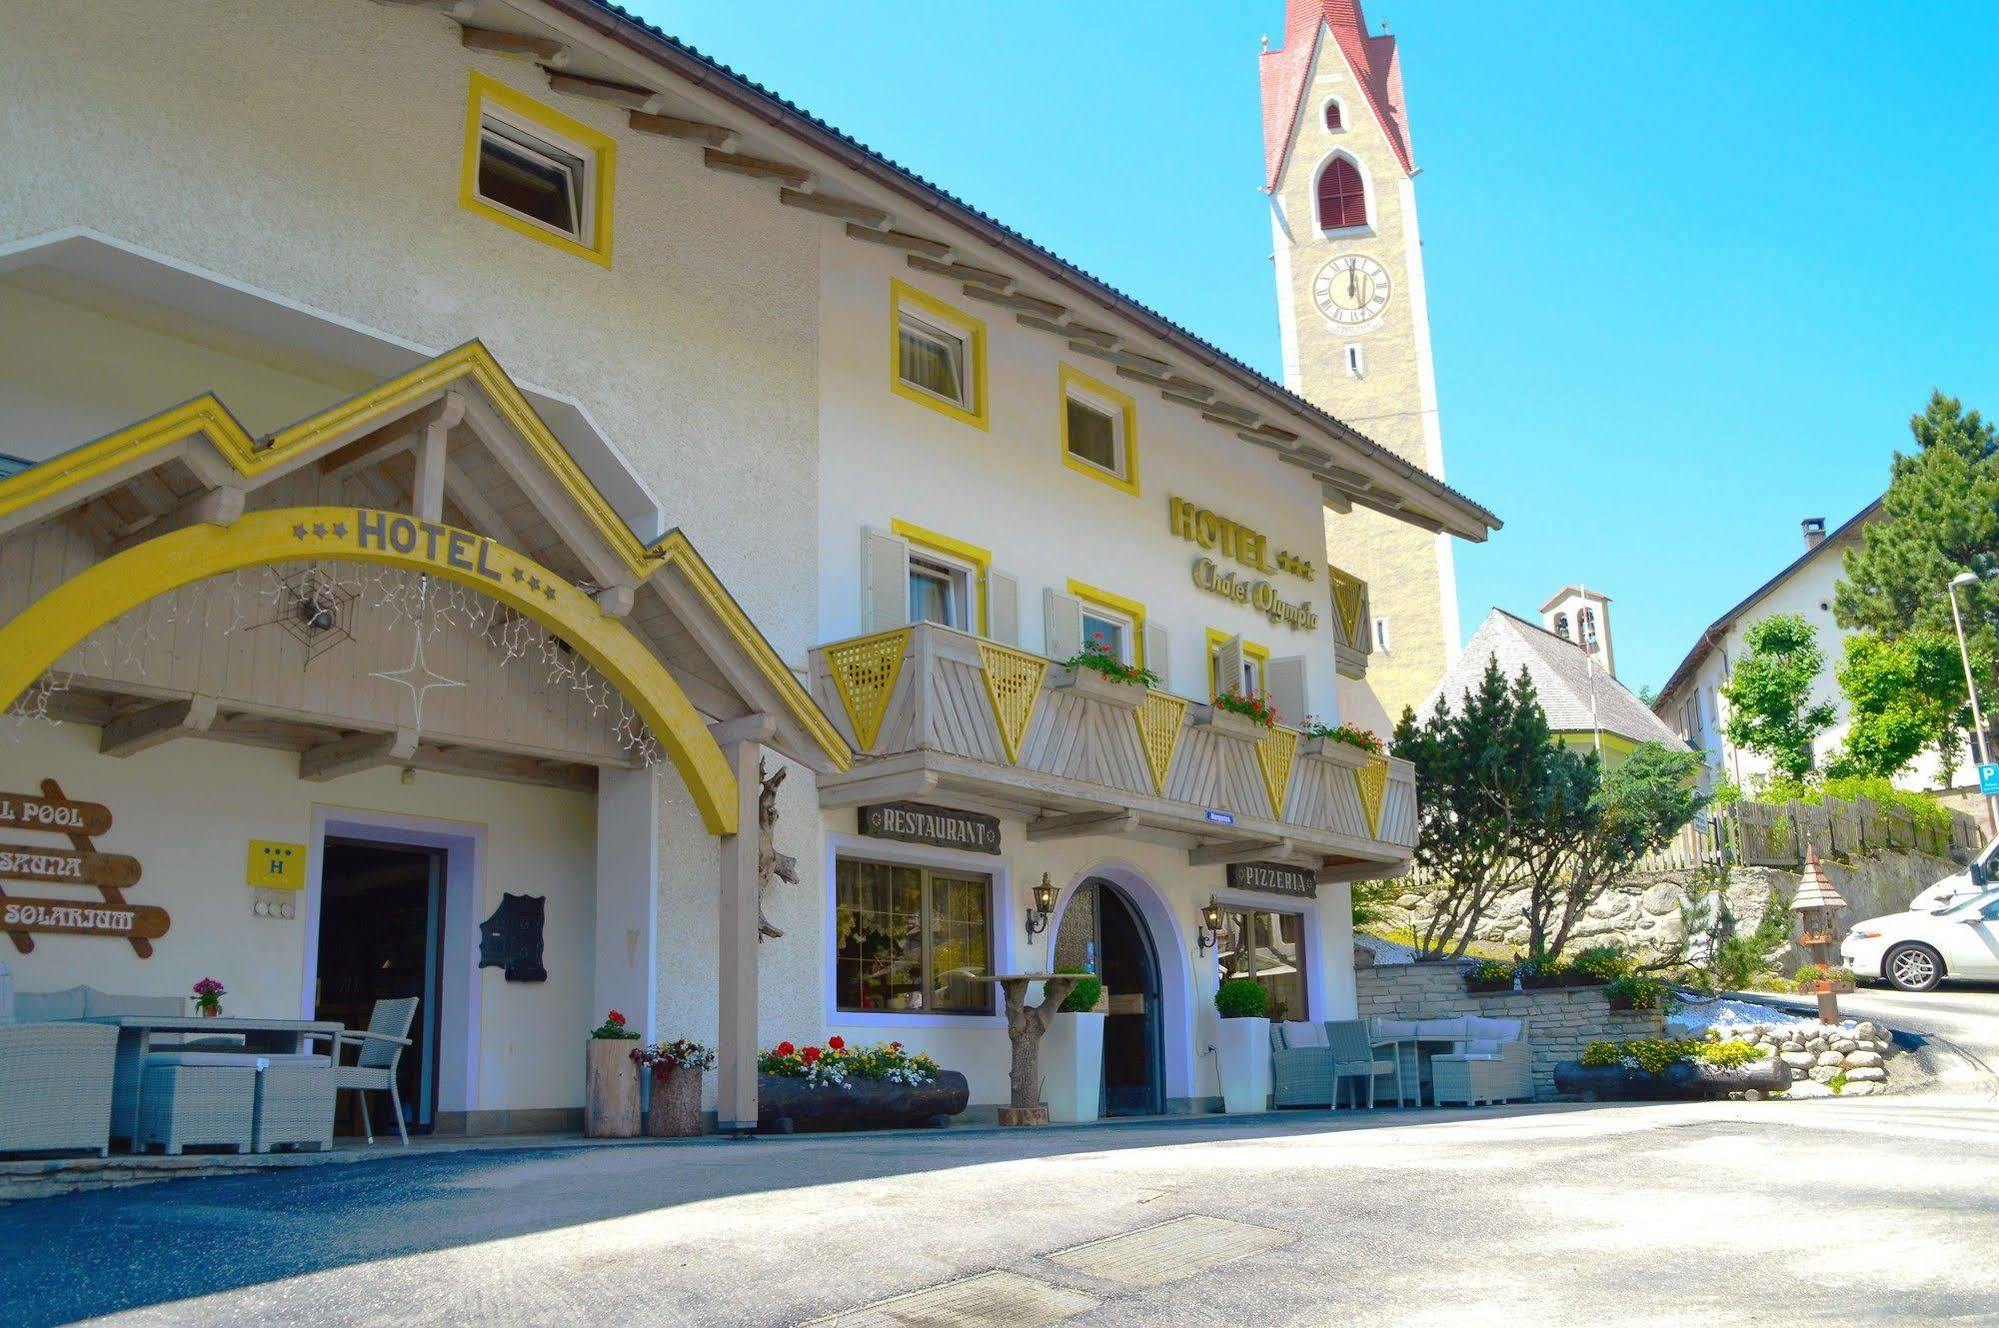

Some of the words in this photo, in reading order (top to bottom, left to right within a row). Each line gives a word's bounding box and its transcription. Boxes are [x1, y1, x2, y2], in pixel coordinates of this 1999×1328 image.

[357, 510, 502, 581] HOTEL
[1169, 496, 1277, 576] HOTEL
[1192, 557, 1250, 604] Chalet
[1252, 580, 1319, 632] Olympia
[22, 803, 84, 828] POOL
[883, 808, 986, 845] RESTAURANT
[0, 853, 82, 877] SAUNA
[270, 860, 284, 874] H
[1245, 866, 1306, 892] PIZZERIA
[4, 904, 135, 931] SOLARIUM
